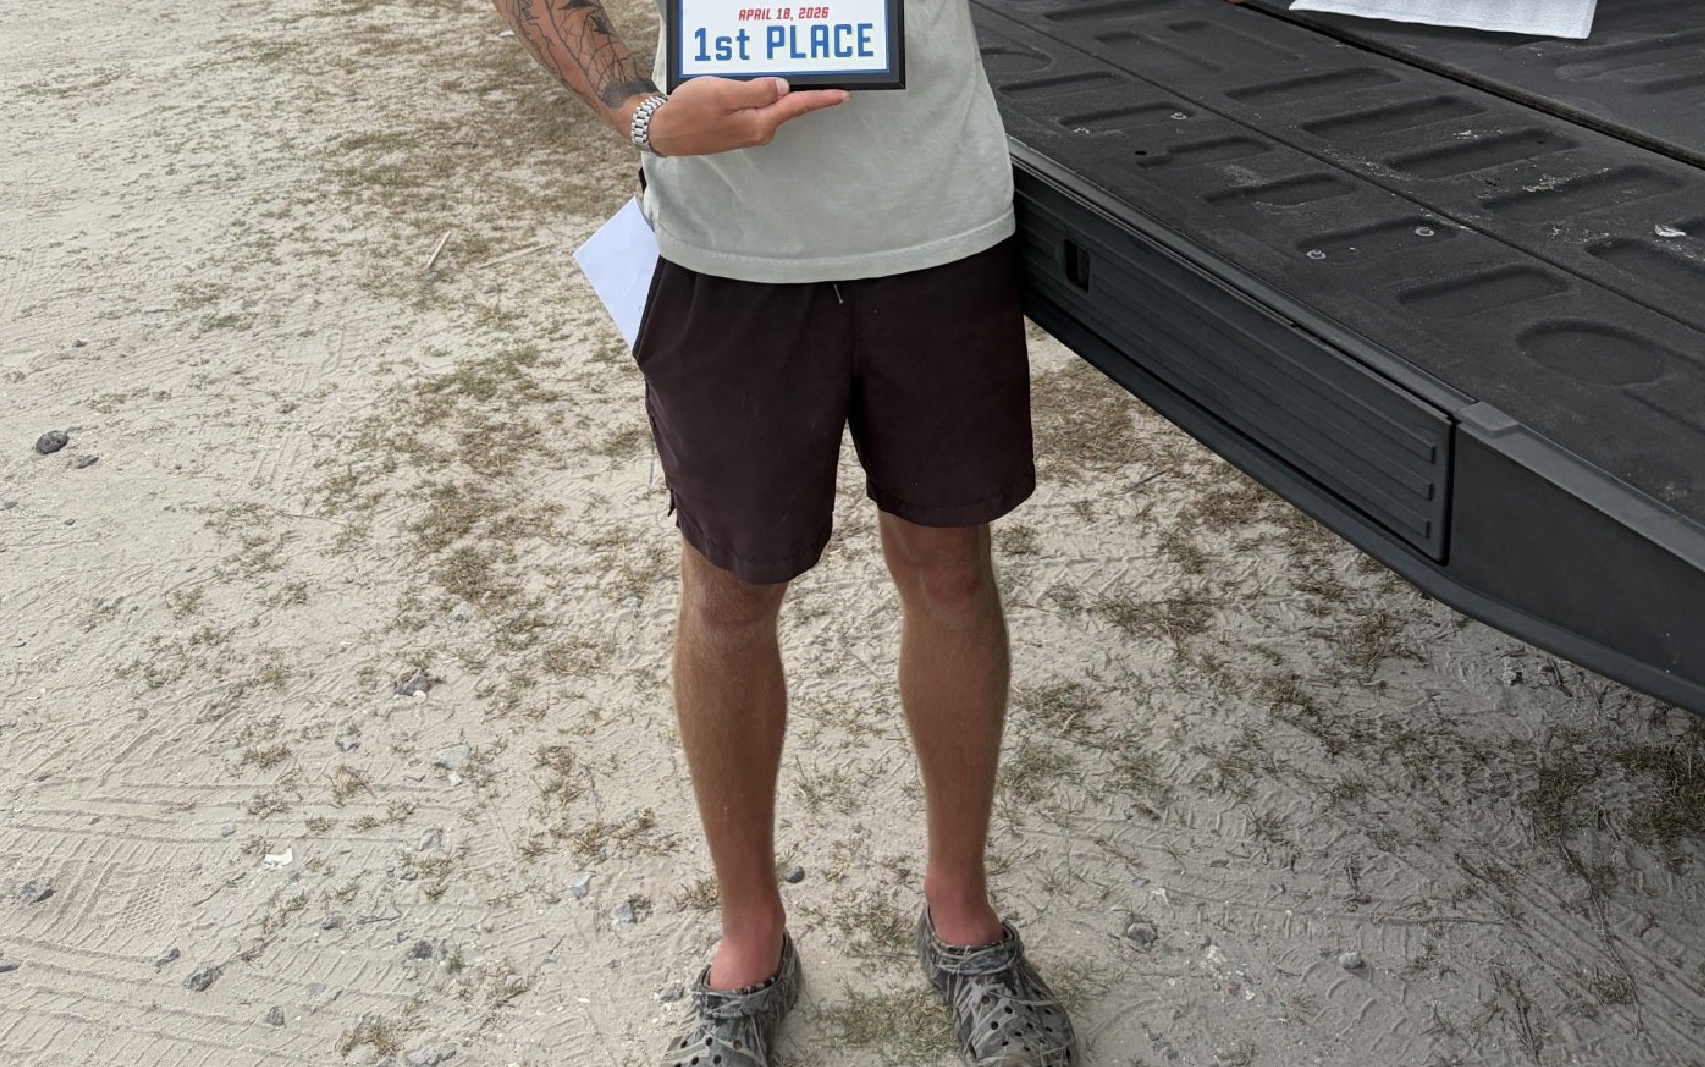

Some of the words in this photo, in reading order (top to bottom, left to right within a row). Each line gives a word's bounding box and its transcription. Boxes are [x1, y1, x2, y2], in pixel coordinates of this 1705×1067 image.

[739, 8, 771, 21] APRIL
[798, 6, 829, 19] 2026
[694, 27, 751, 62] 1st
[766, 23, 875, 60] PLACE
